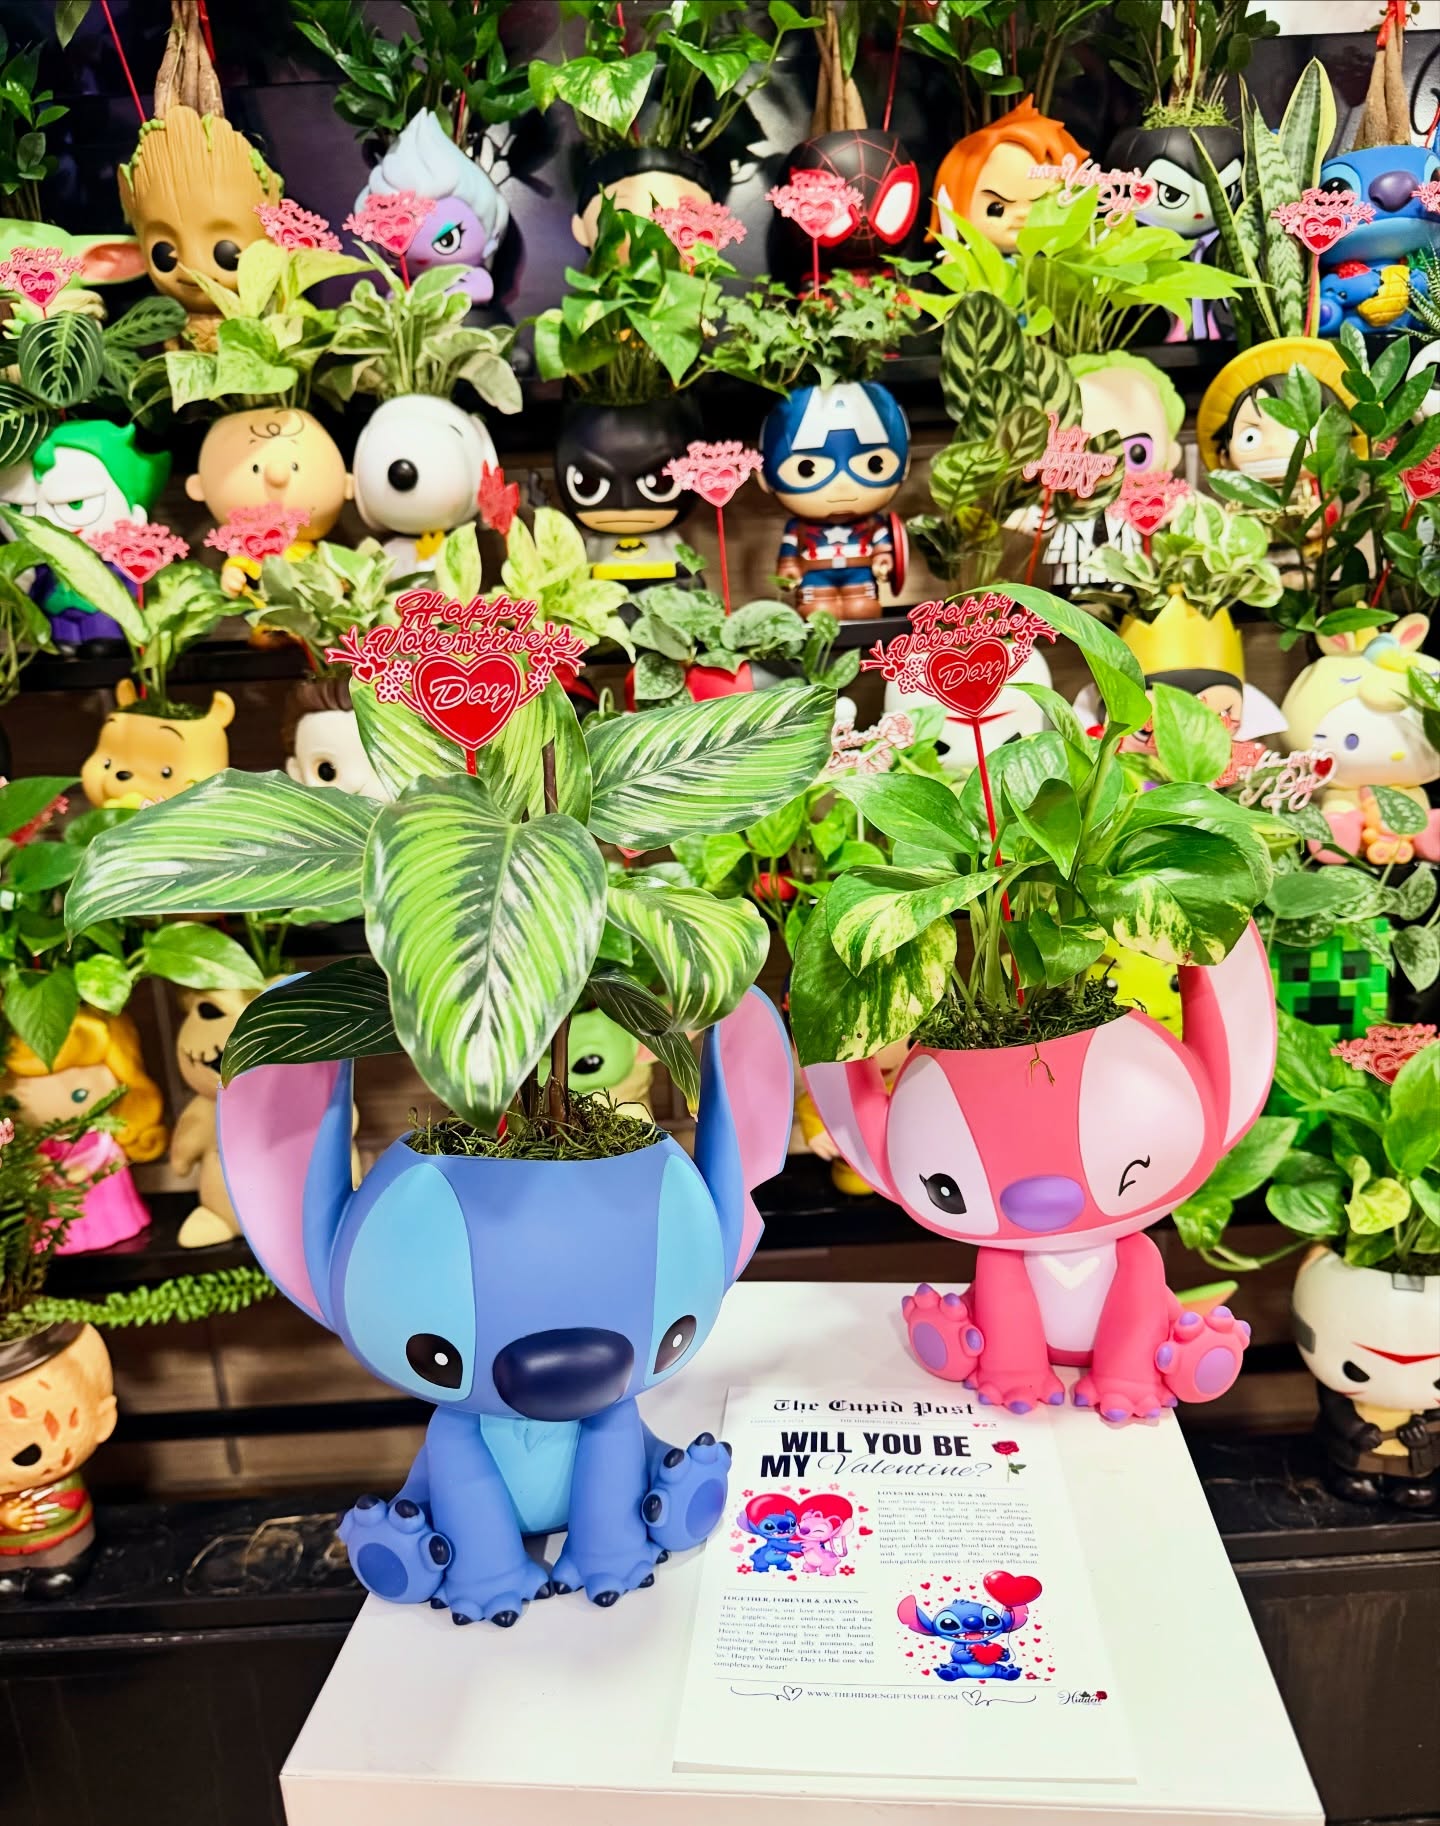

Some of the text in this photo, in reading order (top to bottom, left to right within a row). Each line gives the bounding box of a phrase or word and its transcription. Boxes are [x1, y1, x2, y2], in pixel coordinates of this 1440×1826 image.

[396, 588, 539, 631] Happy
[906, 592, 1015, 634] Happy
[364, 622, 578, 656] Valentine's
[938, 660, 1006, 692] Day
[429, 675, 513, 713] Day
[773, 1399, 975, 1417] The Cupid Post
[781, 1431, 972, 1457] WILL YOU BE
[760, 1453, 992, 1478] MY Valentine?
